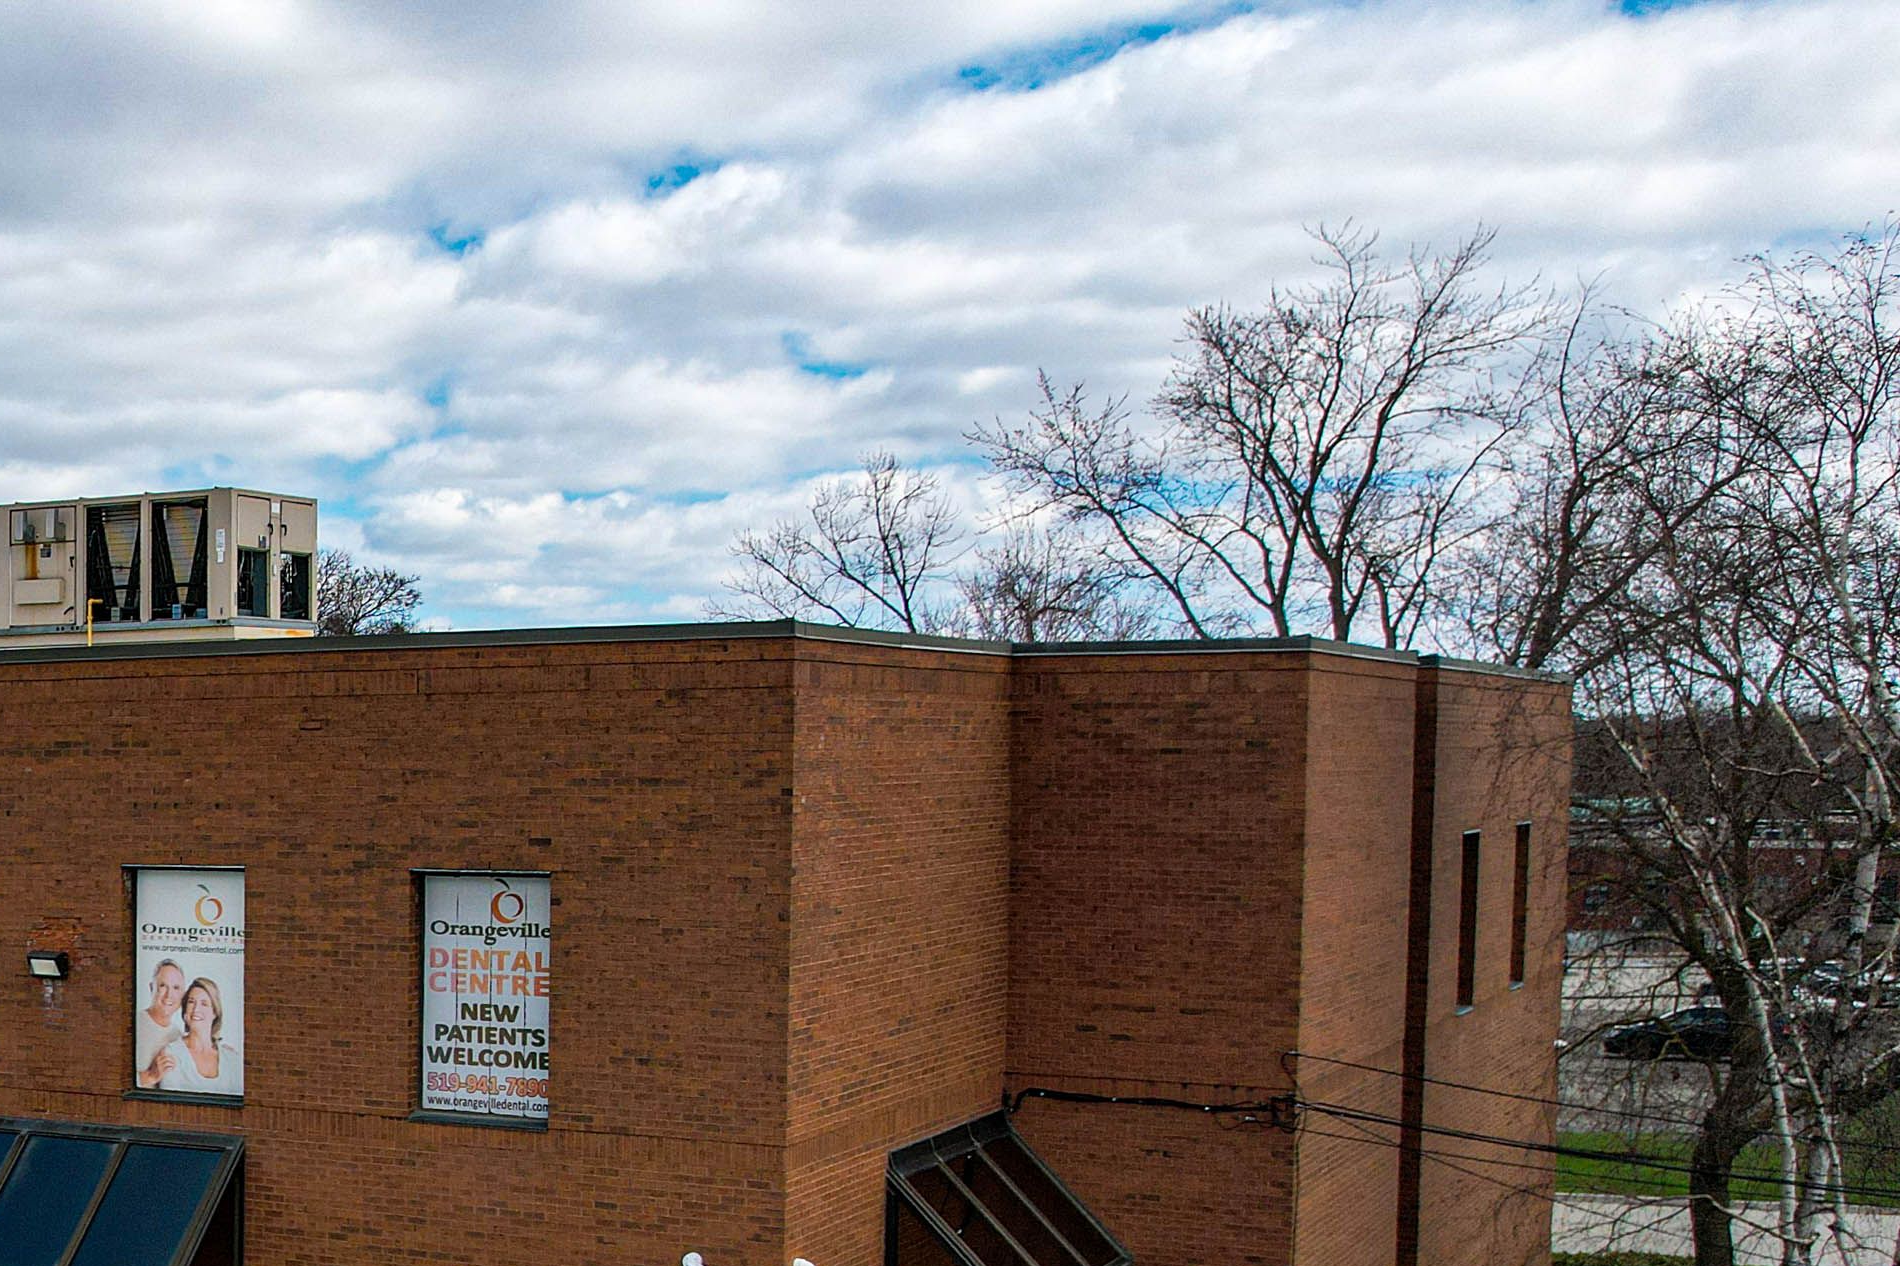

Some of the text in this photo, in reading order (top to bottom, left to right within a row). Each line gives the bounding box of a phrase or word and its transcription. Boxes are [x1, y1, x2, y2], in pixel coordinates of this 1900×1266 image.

[142, 923, 246, 942] Orangeville
[430, 920, 551, 946] Orangeville
[429, 947, 550, 973] DENTAL
[428, 971, 550, 997] CENTRE
[460, 1003, 520, 1023] NEW
[434, 1024, 546, 1047] PATIENTS
[426, 1046, 549, 1070] WELCOME
[426, 1071, 549, 1098] 519-941-7890
